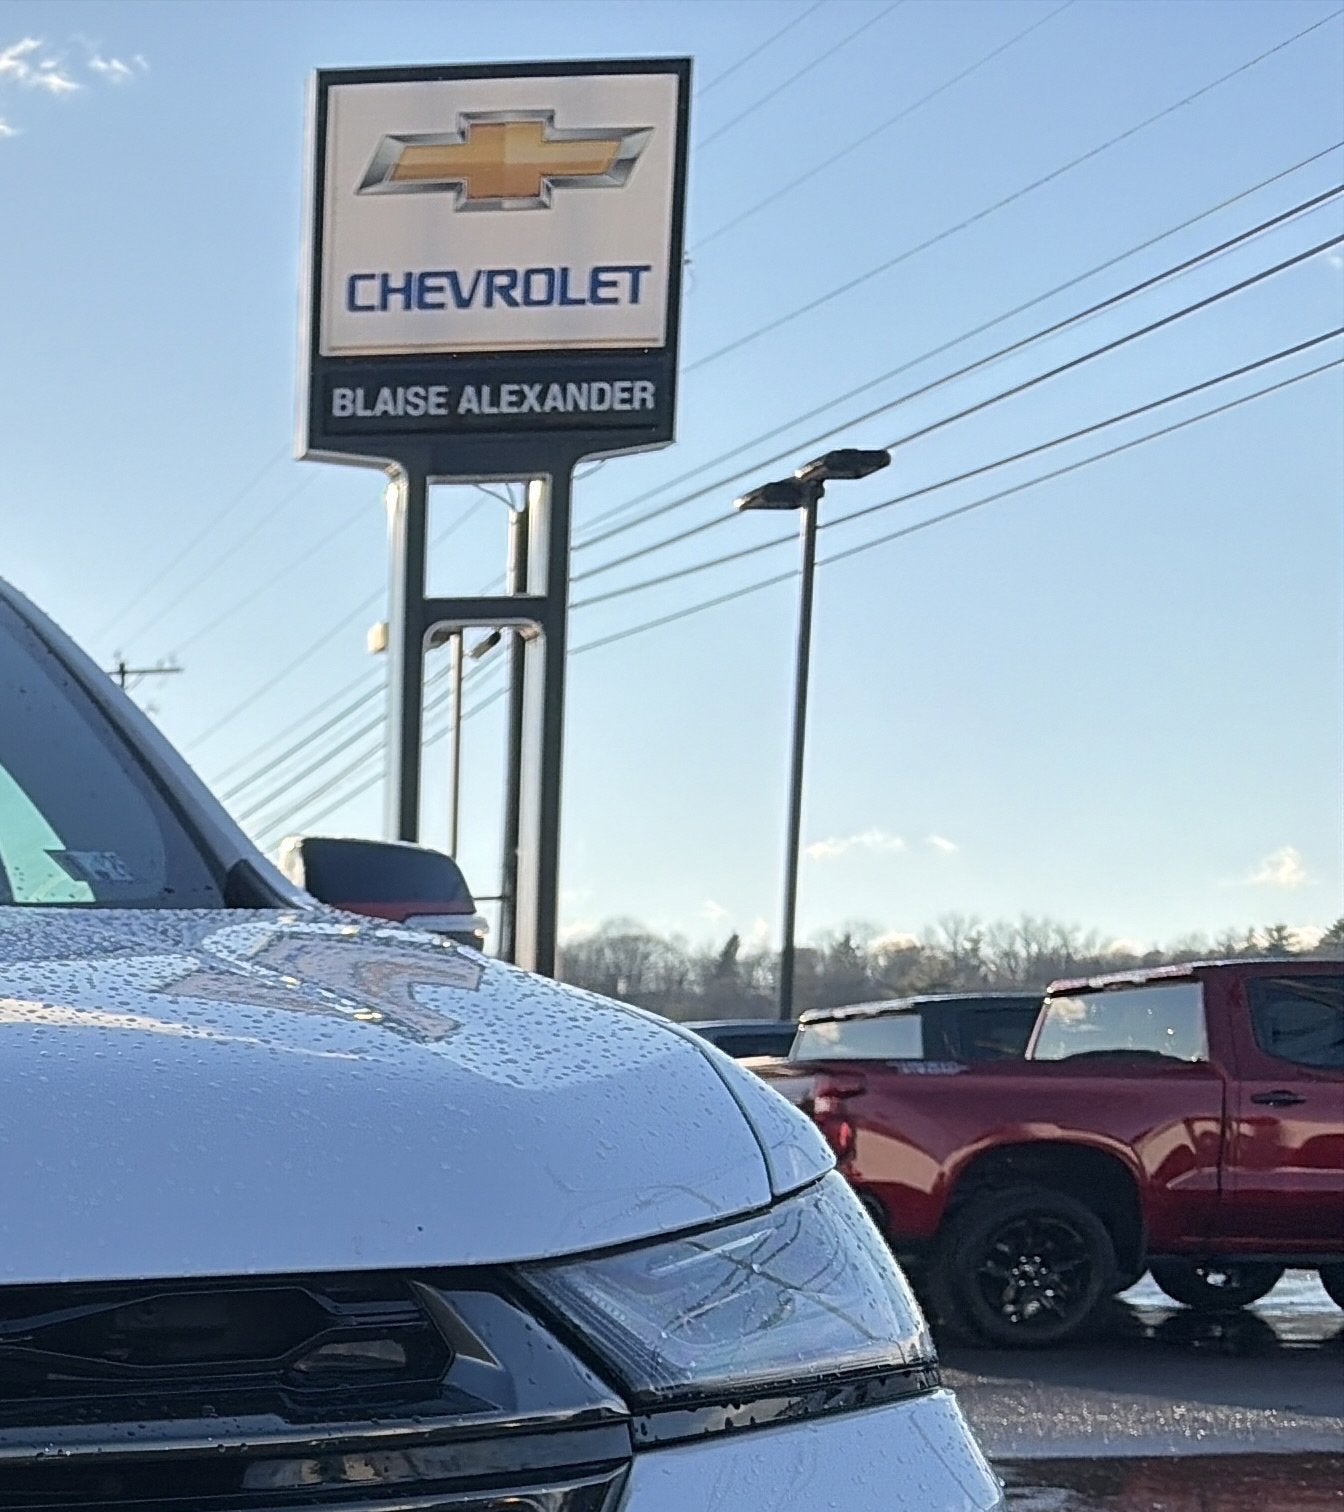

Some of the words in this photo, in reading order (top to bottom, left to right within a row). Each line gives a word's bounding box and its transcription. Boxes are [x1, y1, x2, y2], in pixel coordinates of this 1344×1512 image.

[346, 264, 652, 313] CHEVROLET
[332, 385, 449, 417] BLAISE
[457, 380, 656, 414] ALEXANDER
